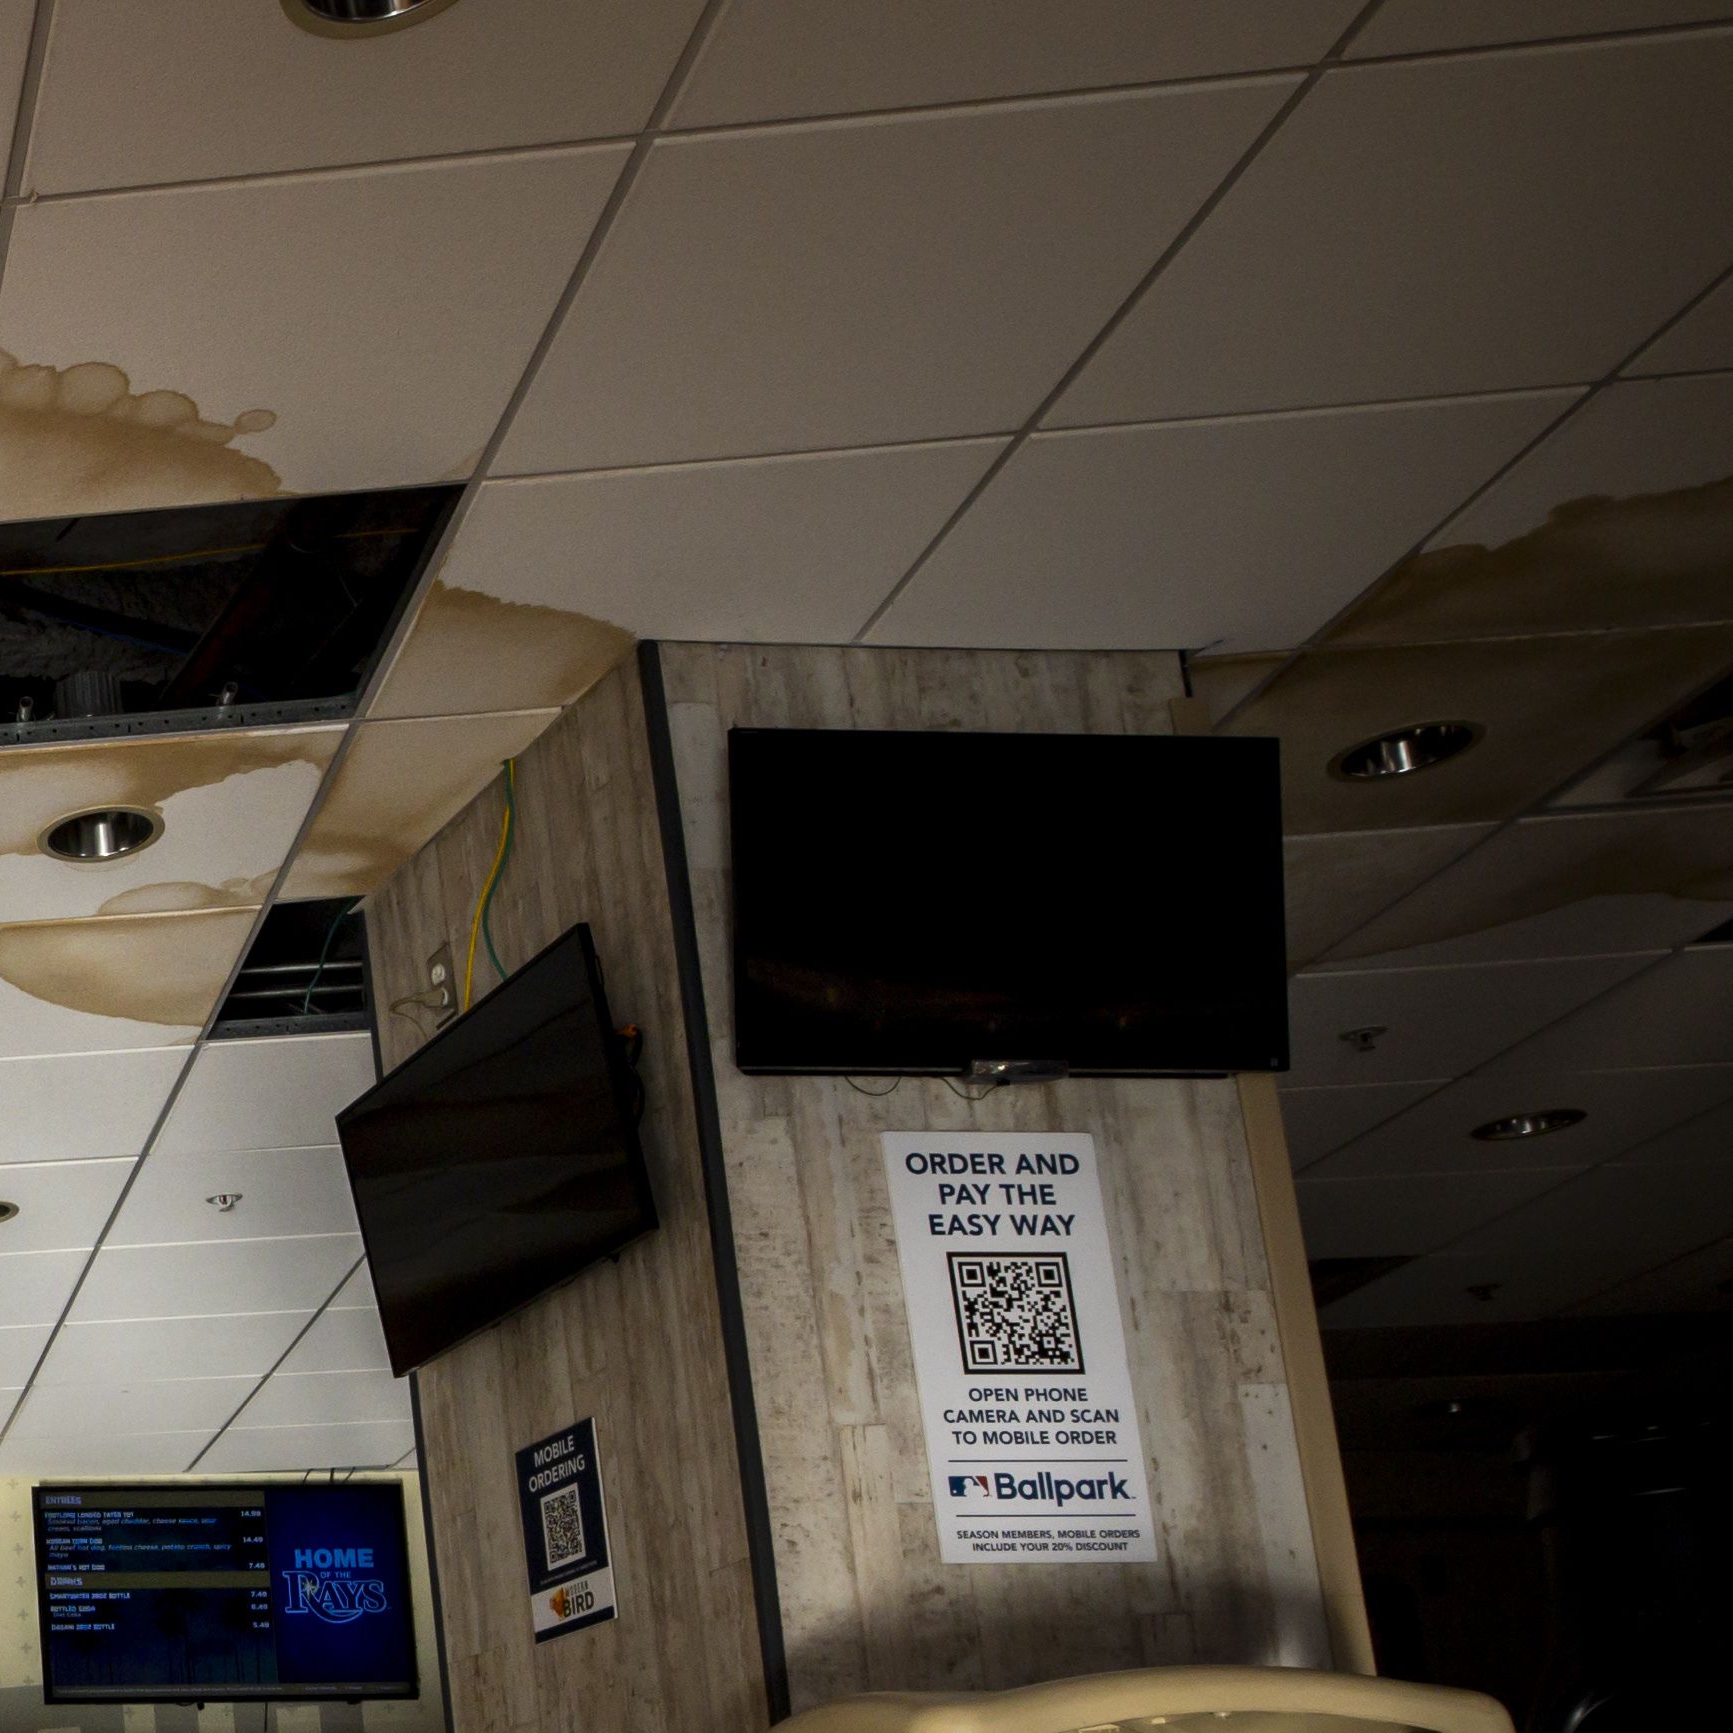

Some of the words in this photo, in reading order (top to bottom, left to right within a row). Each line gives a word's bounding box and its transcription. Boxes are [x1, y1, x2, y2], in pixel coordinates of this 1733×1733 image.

[905, 1152, 1006, 1175] ORDER
[1015, 1153, 1080, 1175] AND
[938, 1183, 991, 1205] PAY
[999, 1183, 1057, 1205] THE
[928, 1214, 1001, 1236] EASY
[1010, 1214, 1075, 1236] WAY
[968, 1388, 1019, 1402] OPEN
[1025, 1388, 1088, 1402] PHONE
[943, 1409, 1021, 1423] CAMERA
[1026, 1409, 1065, 1423] AND
[1070, 1409, 1120, 1423] SCAN
[952, 1431, 977, 1445] TO
[983, 1431, 1050, 1445] MOBILE
[1055, 1430, 1117, 1445] ORDER
[533, 1435, 575, 1468] MOBILE
[528, 1453, 586, 1493] ORDERING
[994, 1471, 1131, 1507] Ballpark
[956, 1530, 999, 1539] SEASON
[1001, 1530, 1055, 1540] MEMBERS,
[1057, 1530, 1096, 1539] MOBILE
[1099, 1530, 1140, 1539] ORDERS
[972, 1542, 1018, 1551] INCLUDE
[1020, 1542, 1049, 1551] YOUR
[1052, 1542, 1073, 1551] 20%
[1075, 1542, 1128, 1551] DISCOUNT
[294, 1548, 374, 1569] HOME
[320, 1571, 332, 1579] OF
[335, 1571, 351, 1579] THE
[282, 1571, 387, 1624] RAYS
[563, 1591, 595, 1618] BIRD
